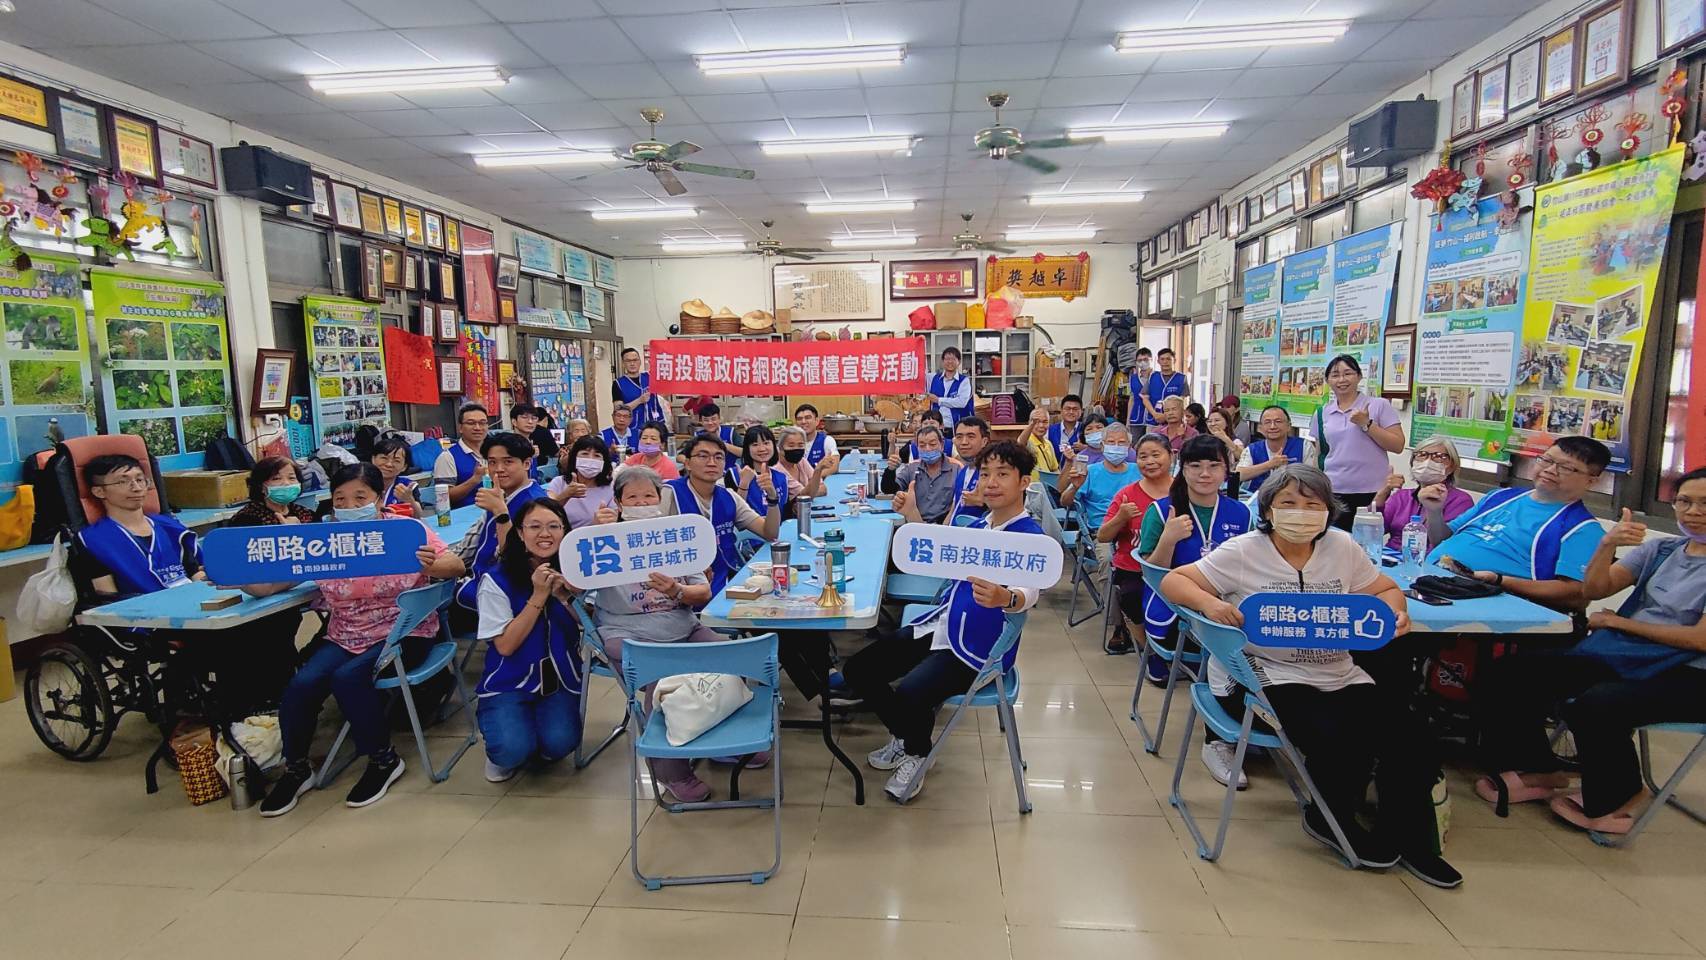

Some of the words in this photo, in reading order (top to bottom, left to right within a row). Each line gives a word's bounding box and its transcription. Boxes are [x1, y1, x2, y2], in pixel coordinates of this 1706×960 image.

[1006, 268, 1067, 287] 卓越獎
[655, 350, 919, 386] 南投縣政府網路e櫃檯宣導活動
[246, 531, 386, 563] 網路e櫃檯
[626, 526, 697, 549] 觀光首都
[304, 563, 346, 573] 南投縣政府
[629, 547, 698, 571] 宜居城市
[939, 544, 1048, 573] 南投縣政府
[1259, 605, 1350, 624] 網路e櫃檯
[1261, 626, 1306, 638] 申辦服務
[1314, 627, 1350, 639] 真方便
